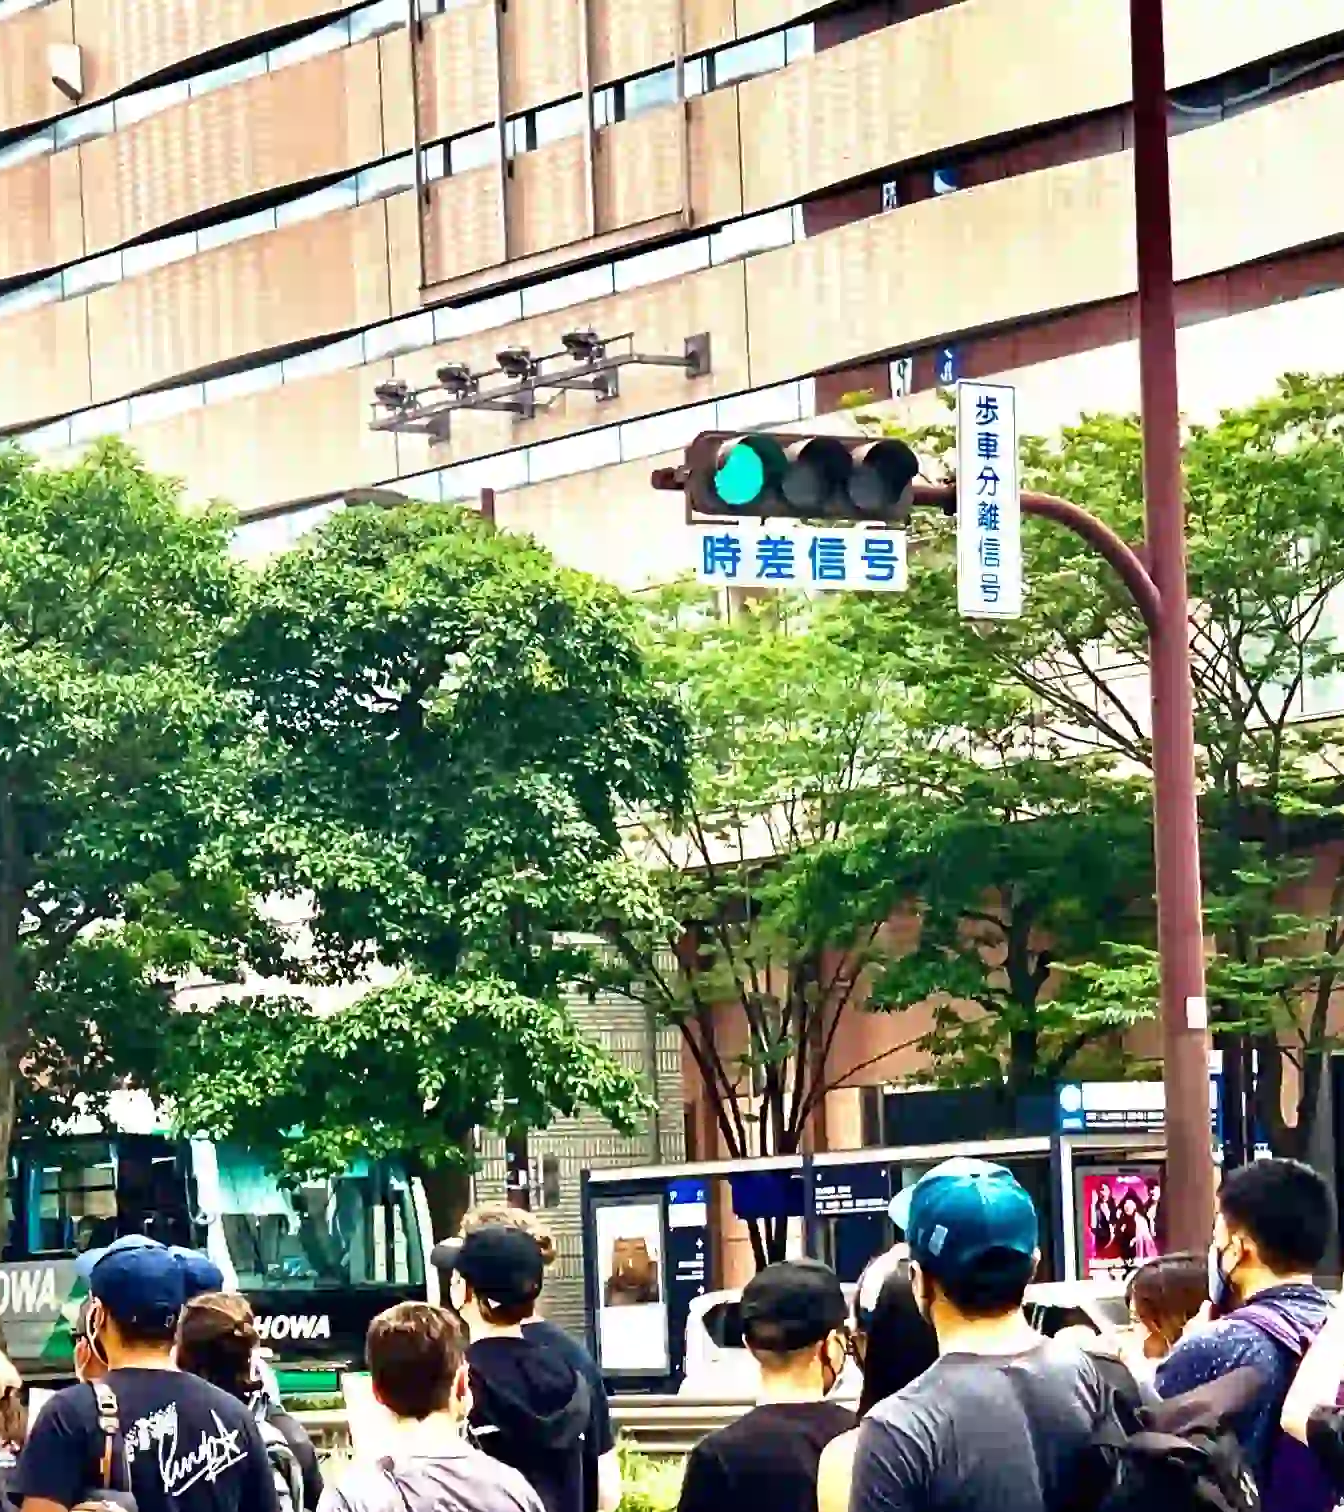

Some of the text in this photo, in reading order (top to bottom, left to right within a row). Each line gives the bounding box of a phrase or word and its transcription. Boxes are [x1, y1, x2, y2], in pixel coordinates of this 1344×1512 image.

[975, 395, 1001, 604] 歩車分離信号
[702, 533, 899, 582] 時差信号
[253, 1314, 330, 1339] HOWA
